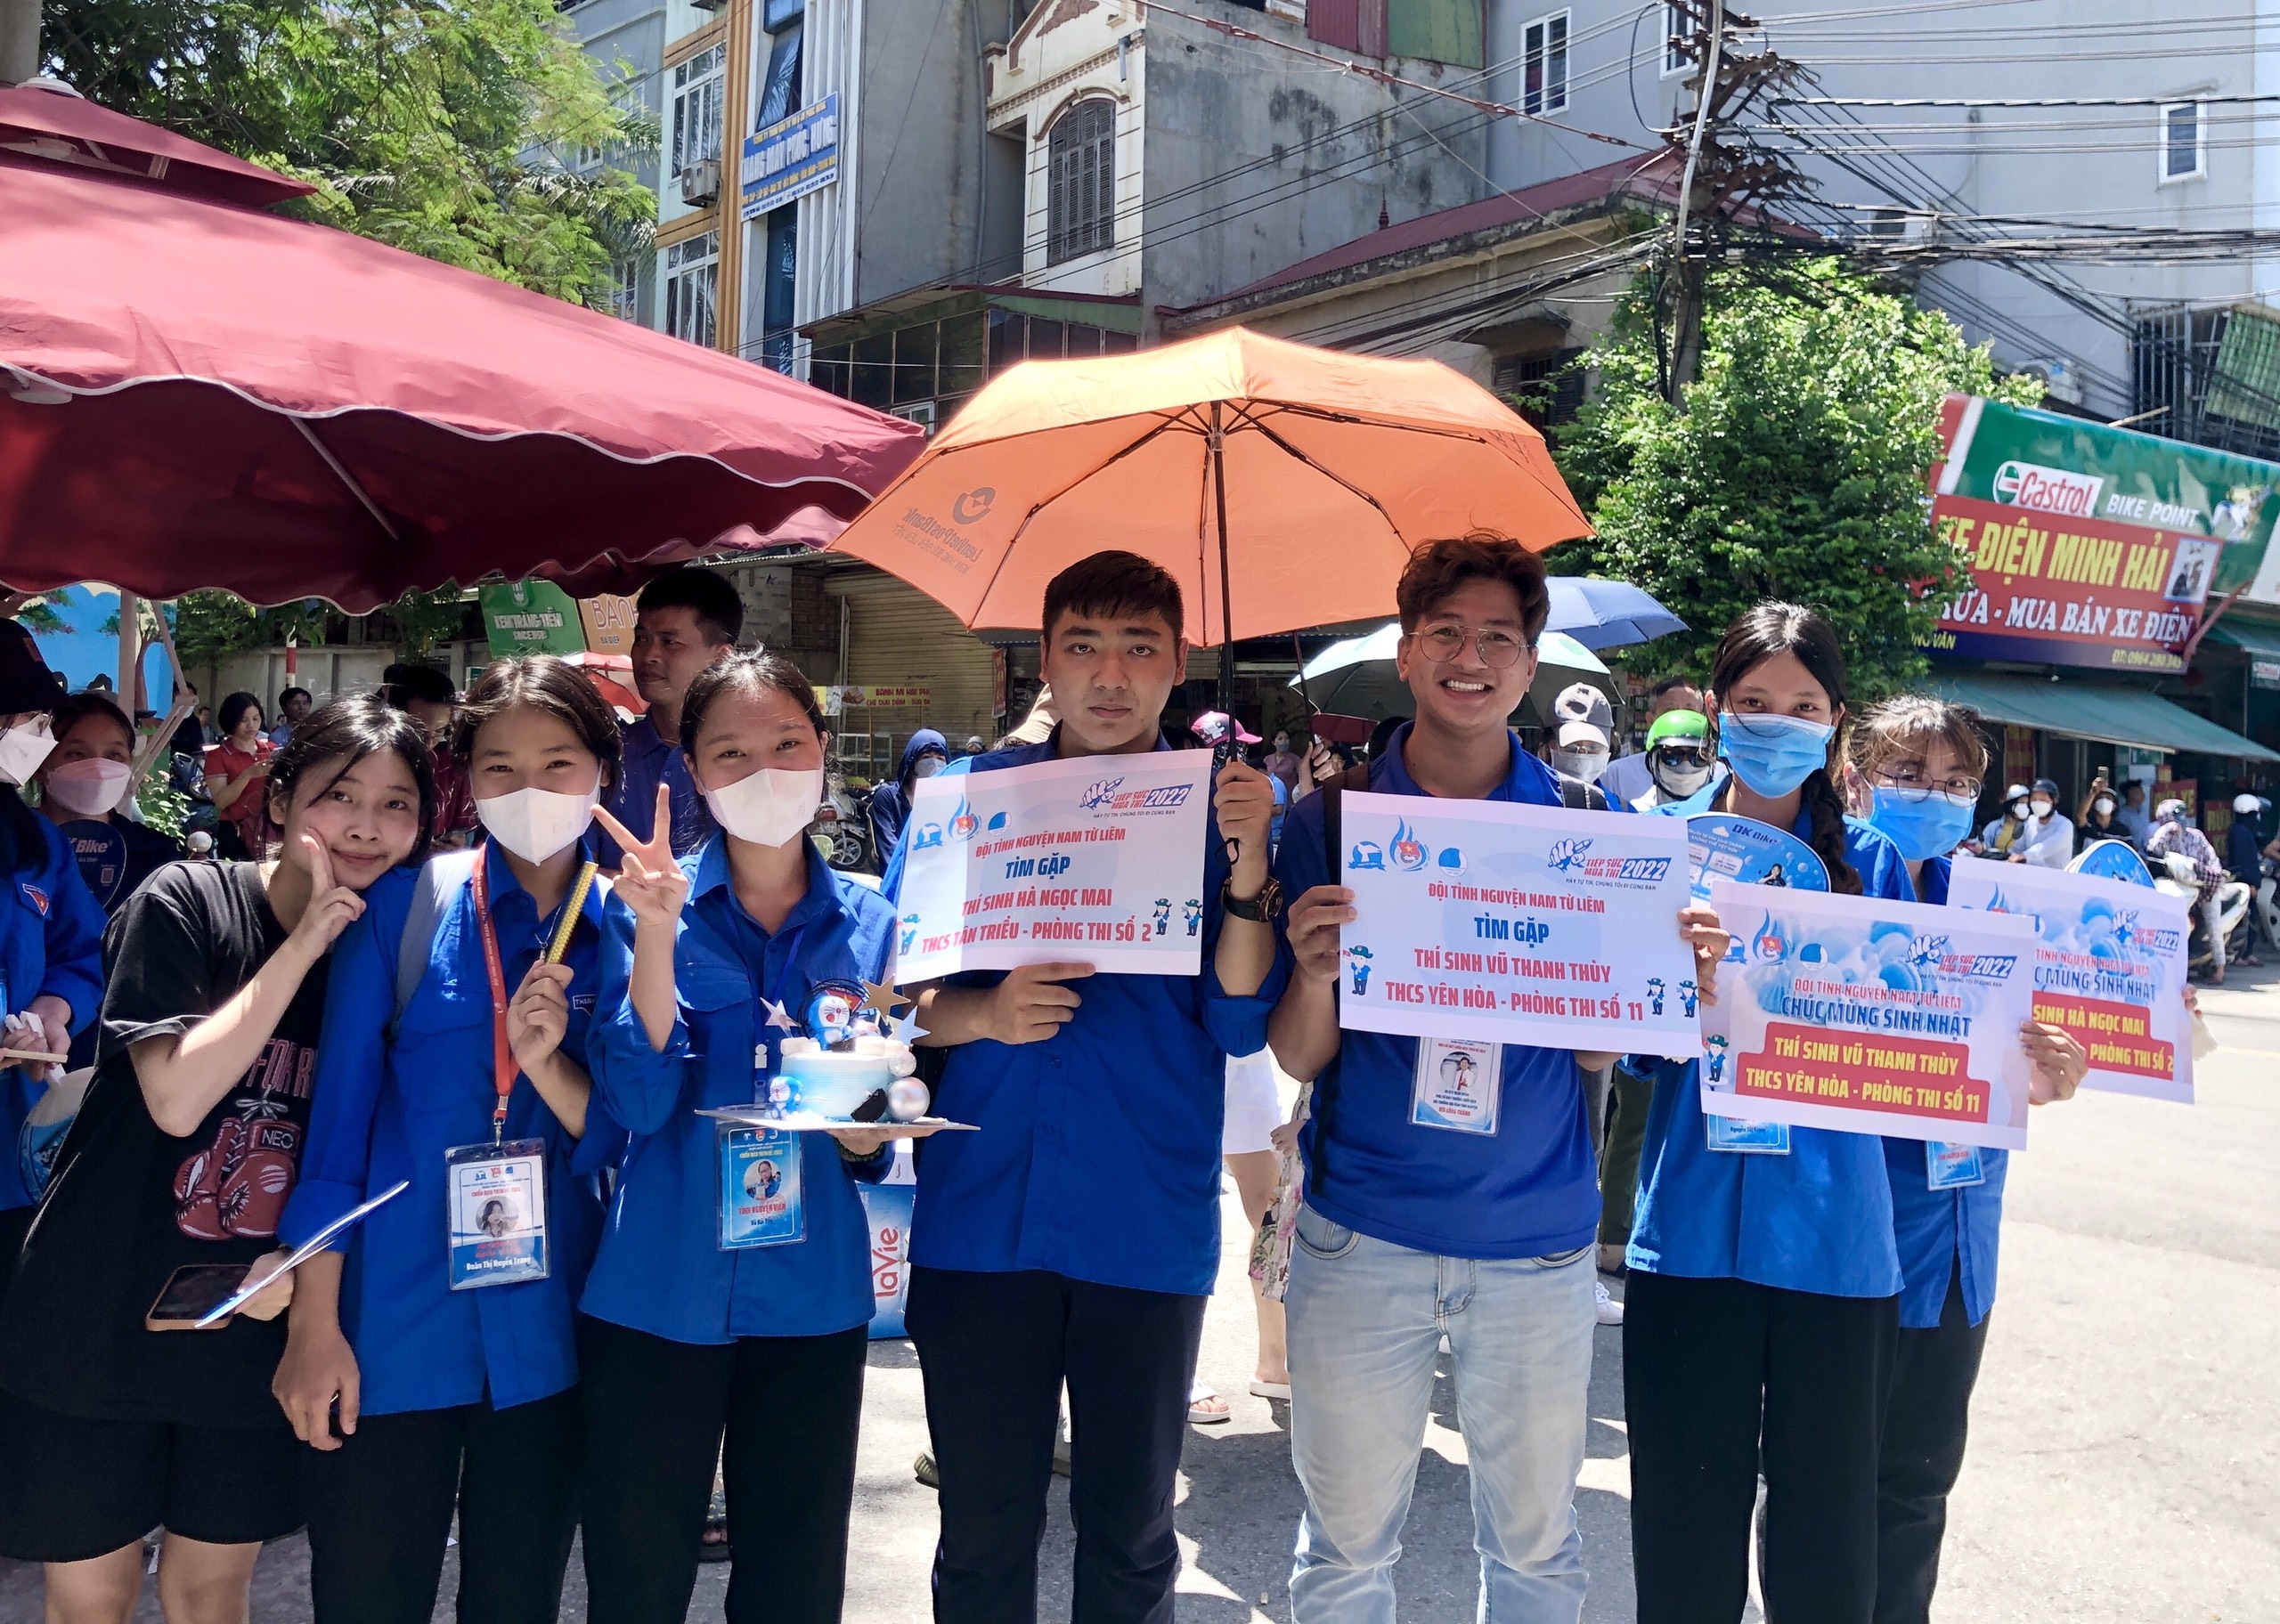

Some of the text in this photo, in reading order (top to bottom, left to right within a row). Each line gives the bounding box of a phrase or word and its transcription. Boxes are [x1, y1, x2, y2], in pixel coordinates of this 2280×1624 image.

[2018, 471, 2094, 516] Castrol
[2105, 494, 2202, 529] BIKE POINT
[1975, 516, 2049, 585] ĐIỆN
[2047, 532, 2123, 587] MINH
[2121, 531, 2170, 592] HẢI
[2005, 596, 2057, 631] MUA
[2060, 597, 2112, 636] BÁN
[2110, 607, 2142, 640] XE
[2141, 605, 2195, 650] ĐIỆN
[1144, 788, 1190, 806] 2022
[76, 839, 109, 853] Bike
[975, 826, 1126, 861] ĐỘI TÌNH NGUYỆN NAM TỪ LIÊM
[1006, 852, 1071, 880] TÌM GẶP
[1621, 859, 1669, 880] 2022
[961, 886, 1112, 917] THÍ SINH HÀ NGỌC MAI
[1429, 881, 1605, 914] ĐỘI TÌNH NGUYỆN NAM TỪ LIÊM
[922, 933, 950, 954] THCS
[953, 926, 977, 946] TÂN
[979, 915, 1020, 942] TRIỀU
[1031, 916, 1084, 940] PHÒNG
[1087, 922, 1112, 941] THI
[1115, 915, 1136, 942] SỐ
[1142, 923, 1152, 942] 2
[1474, 912, 1549, 948] TÌM GẶP
[2155, 930, 2178, 950] 2022
[1414, 946, 1611, 983] THÍ SINH VŨ THANH THÙY
[1972, 957, 2015, 977] 2022
[1891, 988, 1917, 1003] NAM
[2094, 973, 2123, 995] SINH
[1386, 982, 1424, 1003] THCS
[1429, 982, 1458, 1006] YÊN
[1463, 984, 1497, 1010] HÒA
[1510, 989, 1566, 1016] PHÒNG
[1569, 997, 1596, 1018] THI
[1600, 993, 1620, 1019] SỐ
[1628, 1003, 1643, 1021] 11
[1782, 995, 1825, 1021] CHÚC
[1884, 1008, 1924, 1033] SINH
[1926, 1010, 1972, 1042] NHẬT
[2033, 1004, 2145, 1036] SINH HÀ NGỌC MAI
[1775, 1035, 1959, 1076] THÍ SINH VŨ THANH THÙY
[2089, 1041, 2174, 1072] PHÒNG THI SỐ 2
[1747, 1068, 1783, 1090] THCS
[1786, 1070, 1814, 1095] YÊN
[1818, 1074, 1850, 1099] HÒA
[1861, 1079, 1913, 1106] PHÒNG
[1916, 1088, 1941, 1108] THI
[1943, 1085, 1964, 1112] SỐ
[1966, 1094, 1980, 1114] 11
[262, 1129, 294, 1149] NEO
[872, 1227, 899, 1297] laVie
